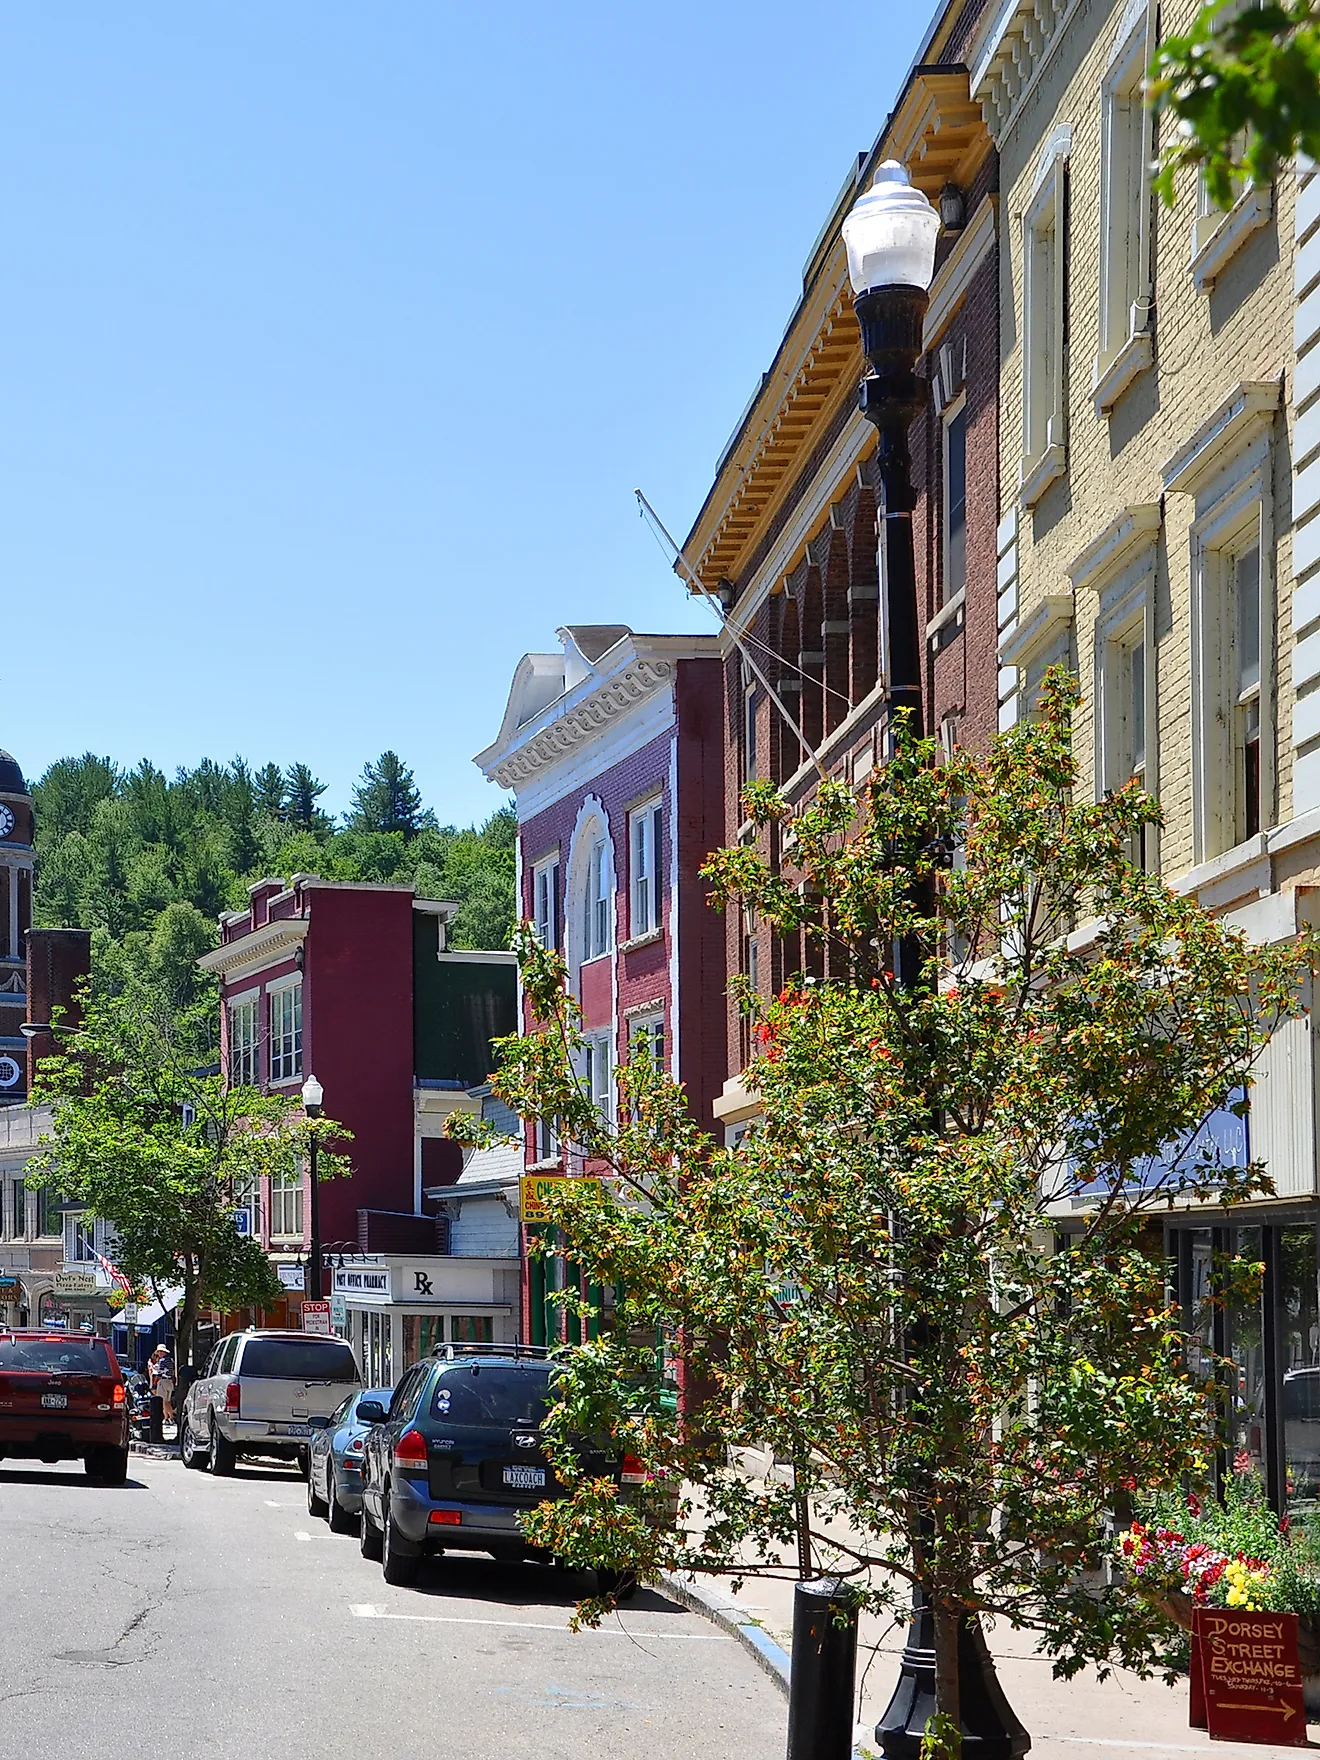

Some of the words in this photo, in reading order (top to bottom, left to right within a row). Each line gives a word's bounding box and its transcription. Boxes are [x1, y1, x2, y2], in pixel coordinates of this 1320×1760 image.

[55, 1274, 76, 1283] Owl's
[78, 1275, 94, 1283] Nest
[303, 1303, 328, 1312] STOP
[504, 1472, 543, 1485] LAXCOACH
[1205, 1618, 1283, 1639] DORSEY
[1211, 1637, 1285, 1659] STREET
[1210, 1656, 1296, 1678] EXCHANGE
